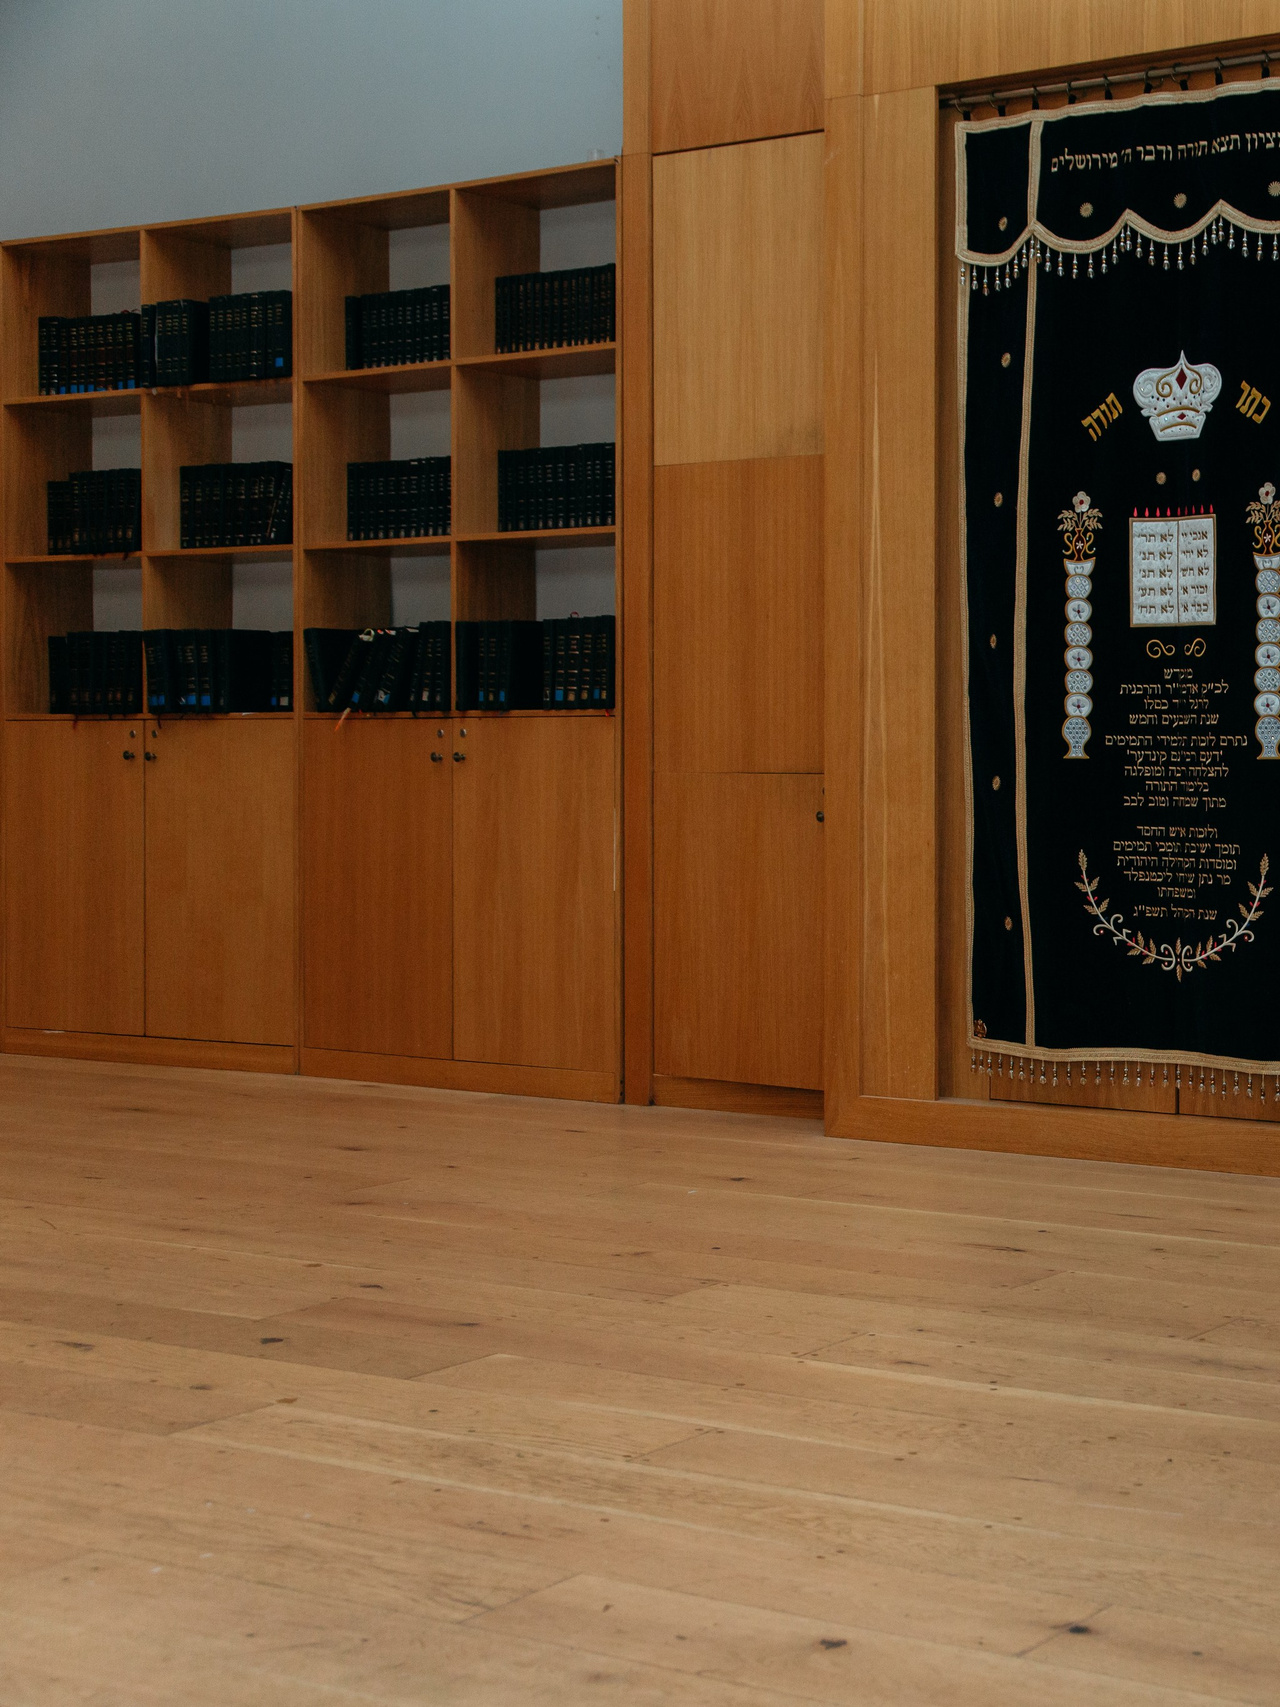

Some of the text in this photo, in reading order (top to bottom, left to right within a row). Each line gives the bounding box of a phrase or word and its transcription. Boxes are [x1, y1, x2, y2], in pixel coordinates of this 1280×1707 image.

[1177, 140, 1208, 160] תורה
[1211, 134, 1241, 154] תצא
[1136, 144, 1173, 161] ודבר
[1051, 148, 1118, 173] מירושלים
[1235, 380, 1272, 424] כתר
[1081, 392, 1123, 441] תורה
[1160, 529, 1173, 542] לא
[1190, 531, 1208, 540] אנכי
[1159, 547, 1172, 560] לא
[1197, 544, 1208, 558] לא
[1159, 565, 1172, 578] לא
[1198, 562, 1209, 576] לא
[1160, 582, 1173, 596] לא
[1161, 600, 1174, 613] לא
[1200, 713, 1219, 725] שנת
[1220, 735, 1247, 746] נתרם
[1145, 781, 1177, 791] התורה
[1202, 796, 1227, 812] מתוך
[1169, 827, 1186, 837] איש
[1198, 873, 1213, 888] נתן
[1216, 874, 1232, 885] מר
